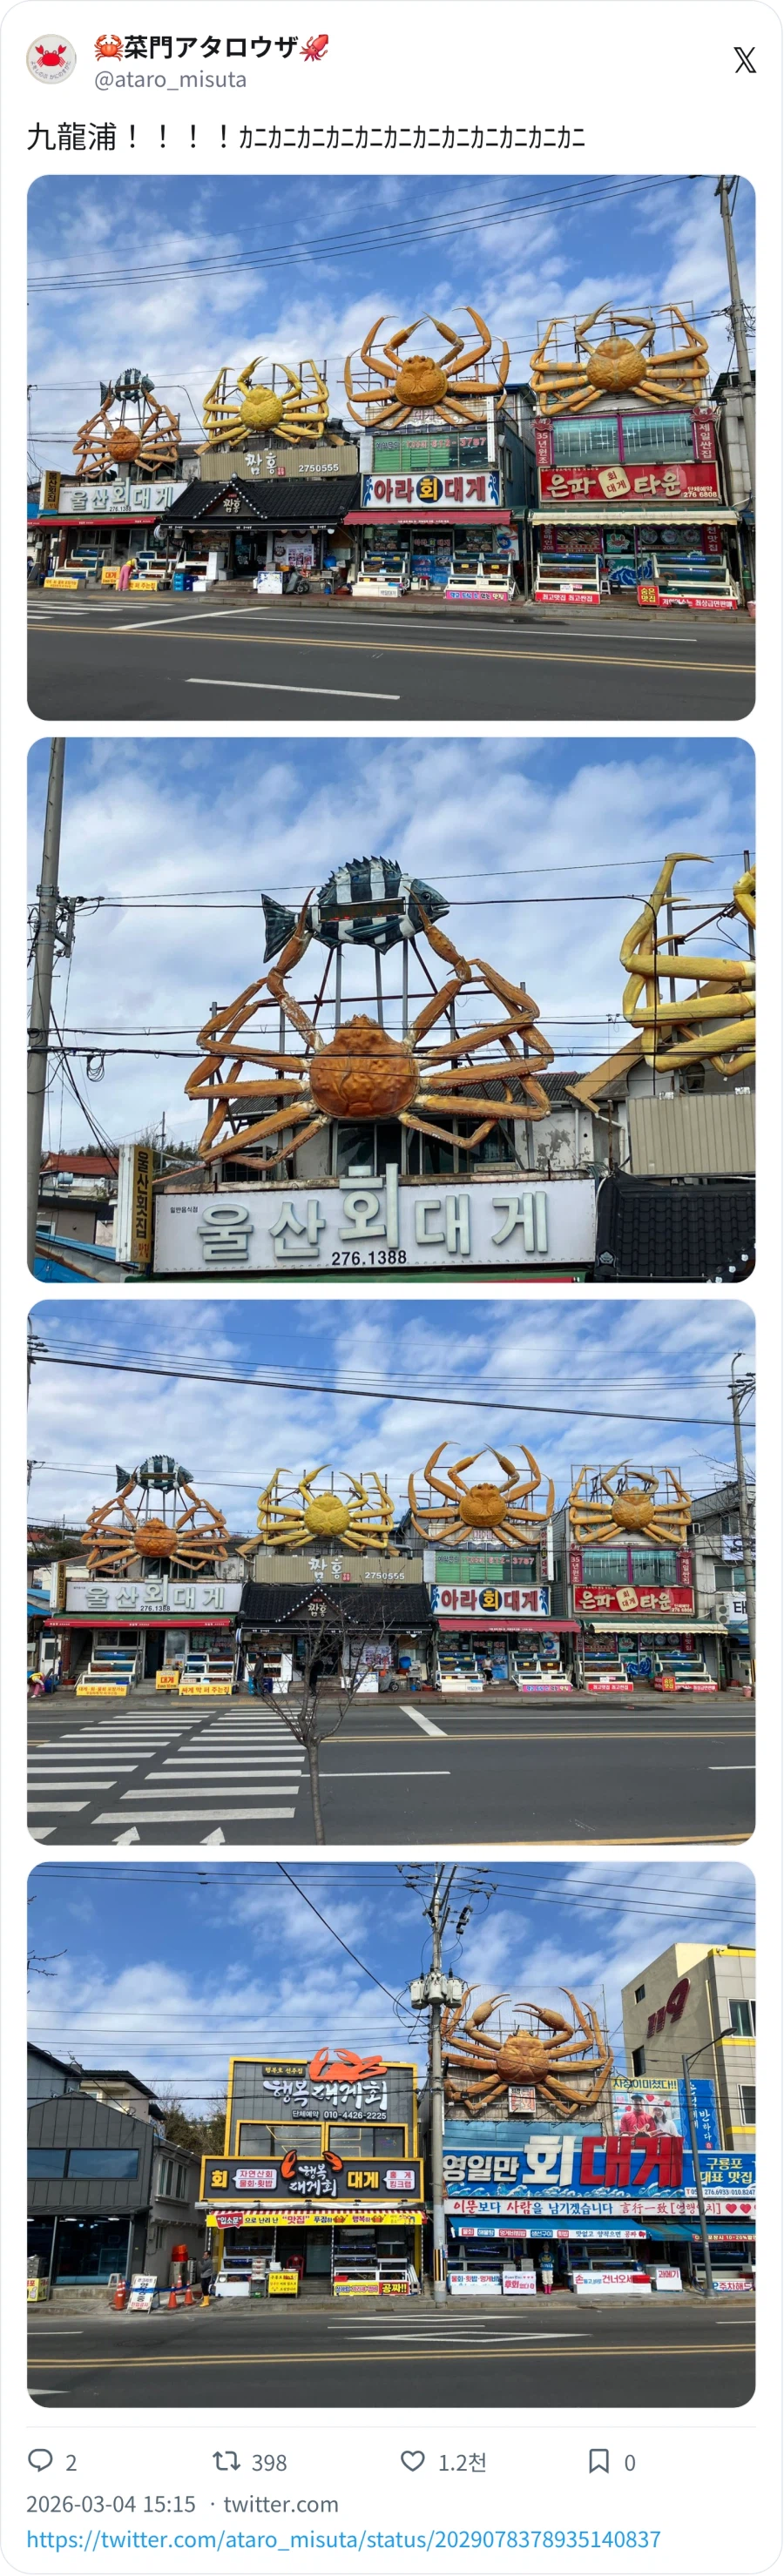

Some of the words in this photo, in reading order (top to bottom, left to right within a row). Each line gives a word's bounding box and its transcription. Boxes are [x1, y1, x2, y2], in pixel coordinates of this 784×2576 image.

[298, 464, 339, 473] 2750555
[606, 471, 617, 481] 회
[71, 477, 173, 511] 울산회대게
[374, 478, 414, 502] 아라
[419, 478, 438, 501] 회
[445, 476, 485, 502] 대게
[547, 474, 596, 498] 은파
[634, 472, 681, 497] 타운
[606, 481, 627, 494] 대게
[136, 1149, 149, 1239] 울산횟집
[197, 1162, 548, 1261] 울산회대게
[332, 1251, 407, 1267] 276.1388
[365, 1571, 405, 1580] 2750555
[86, 1574, 224, 1609] 울산회대게
[441, 1589, 477, 1611] 아라
[483, 1590, 499, 1610] 회
[504, 1591, 538, 1611] 대게
[579, 1591, 615, 1610] 은파
[640, 1591, 671, 1611] 타운
[292, 2110, 319, 2119] 단체예약
[324, 2111, 387, 2120] 010-4426-2225
[443, 2155, 519, 2183] 영일만
[523, 2135, 577, 2188] 회
[580, 2135, 685, 2189] 대게
[706, 2157, 743, 2170] 구룡포
[211, 2169, 227, 2189] 회
[298, 2163, 328, 2180] 행복
[348, 2171, 379, 2189] 대게
[728, 2171, 753, 2184] 맛집
[289, 2179, 338, 2197] 대게회
[453, 2201, 501, 2214] 이문보다
[506, 2201, 544, 2214] 사람을
[549, 2202, 613, 2215] 남기겠습니다
[619, 2202, 668, 2215] 言行一致
[670, 2203, 721, 2215] [언행치]
[382, 2283, 407, 2293] 공짜!!
